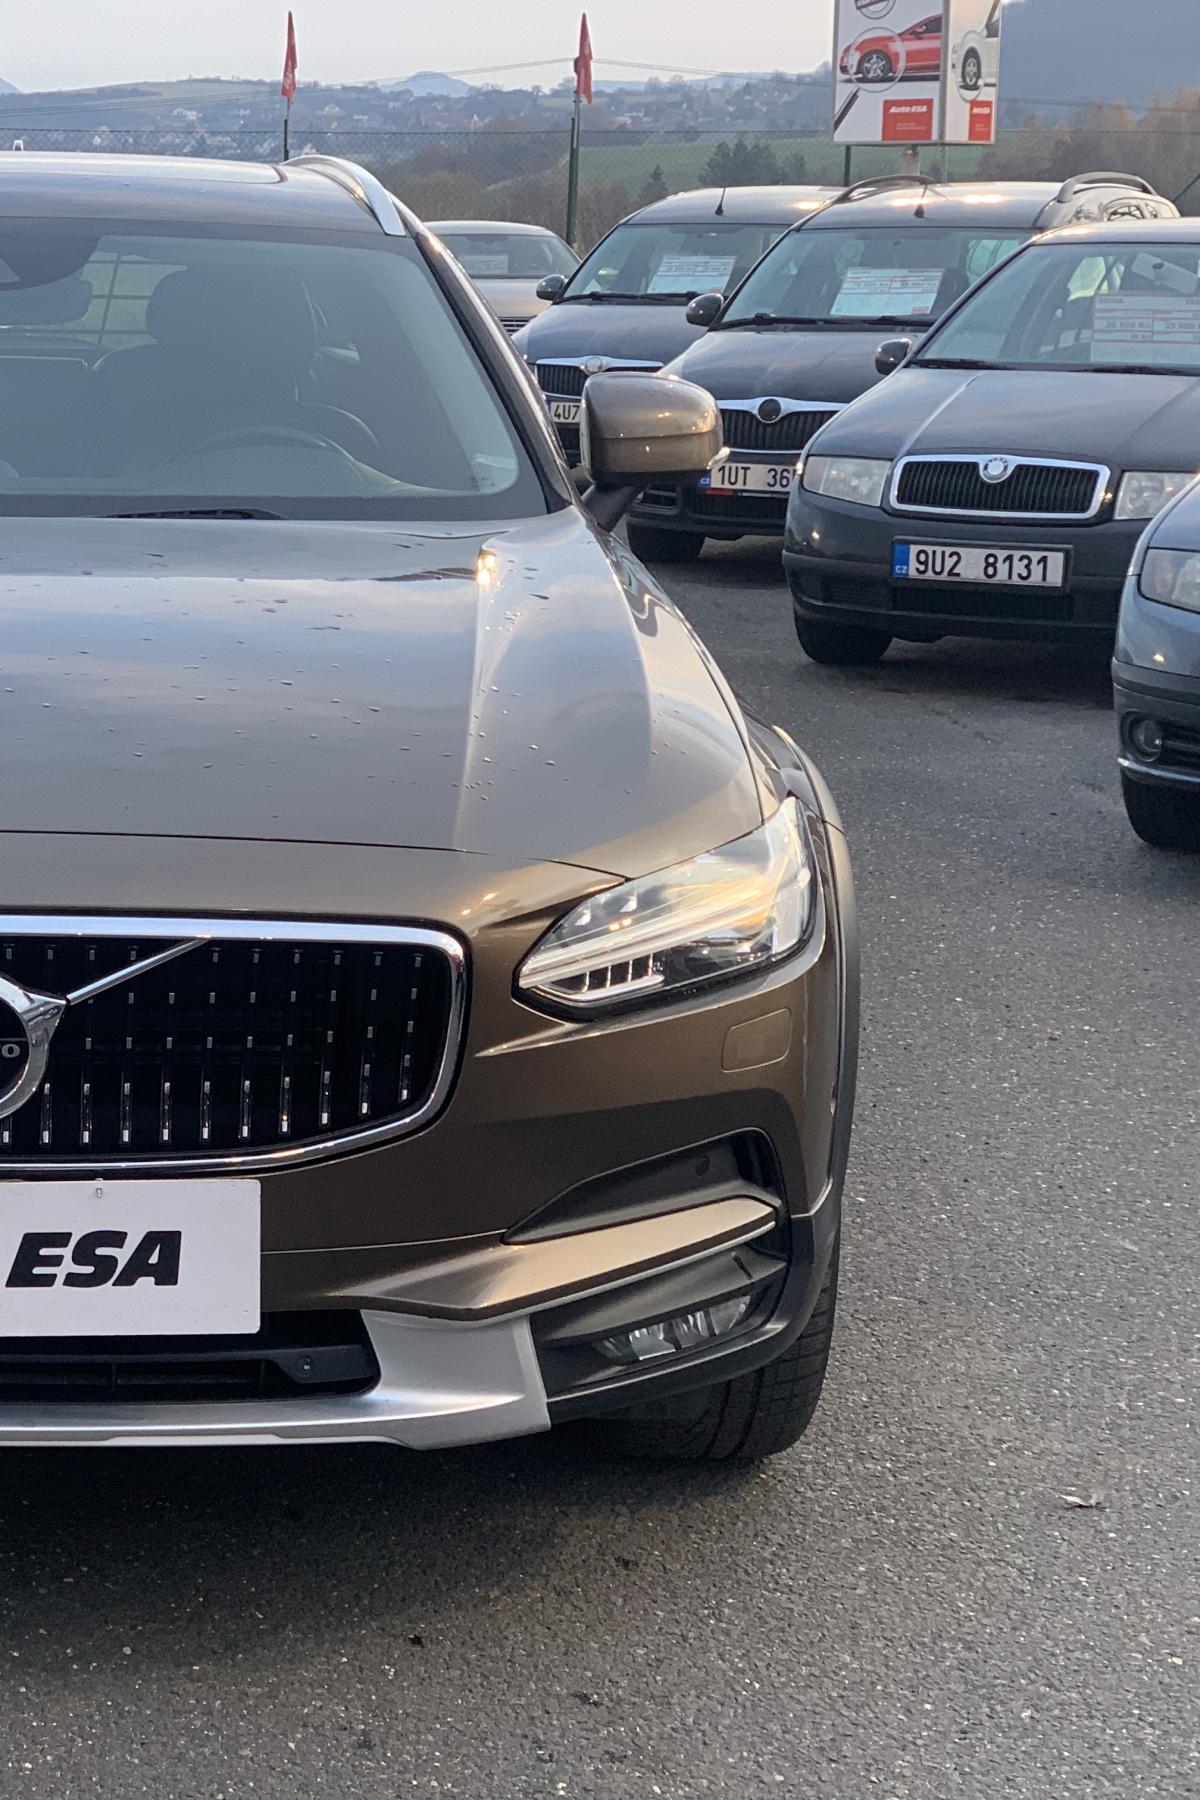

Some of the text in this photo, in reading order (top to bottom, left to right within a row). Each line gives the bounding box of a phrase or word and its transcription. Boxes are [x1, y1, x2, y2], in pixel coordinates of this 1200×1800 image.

[554, 404, 580, 420] 4U7
[718, 465, 797, 488] 1UT 36
[895, 565, 908, 574] CZ
[915, 549, 1049, 582] 9U2 8131
[5, 1229, 182, 1288] ESA
